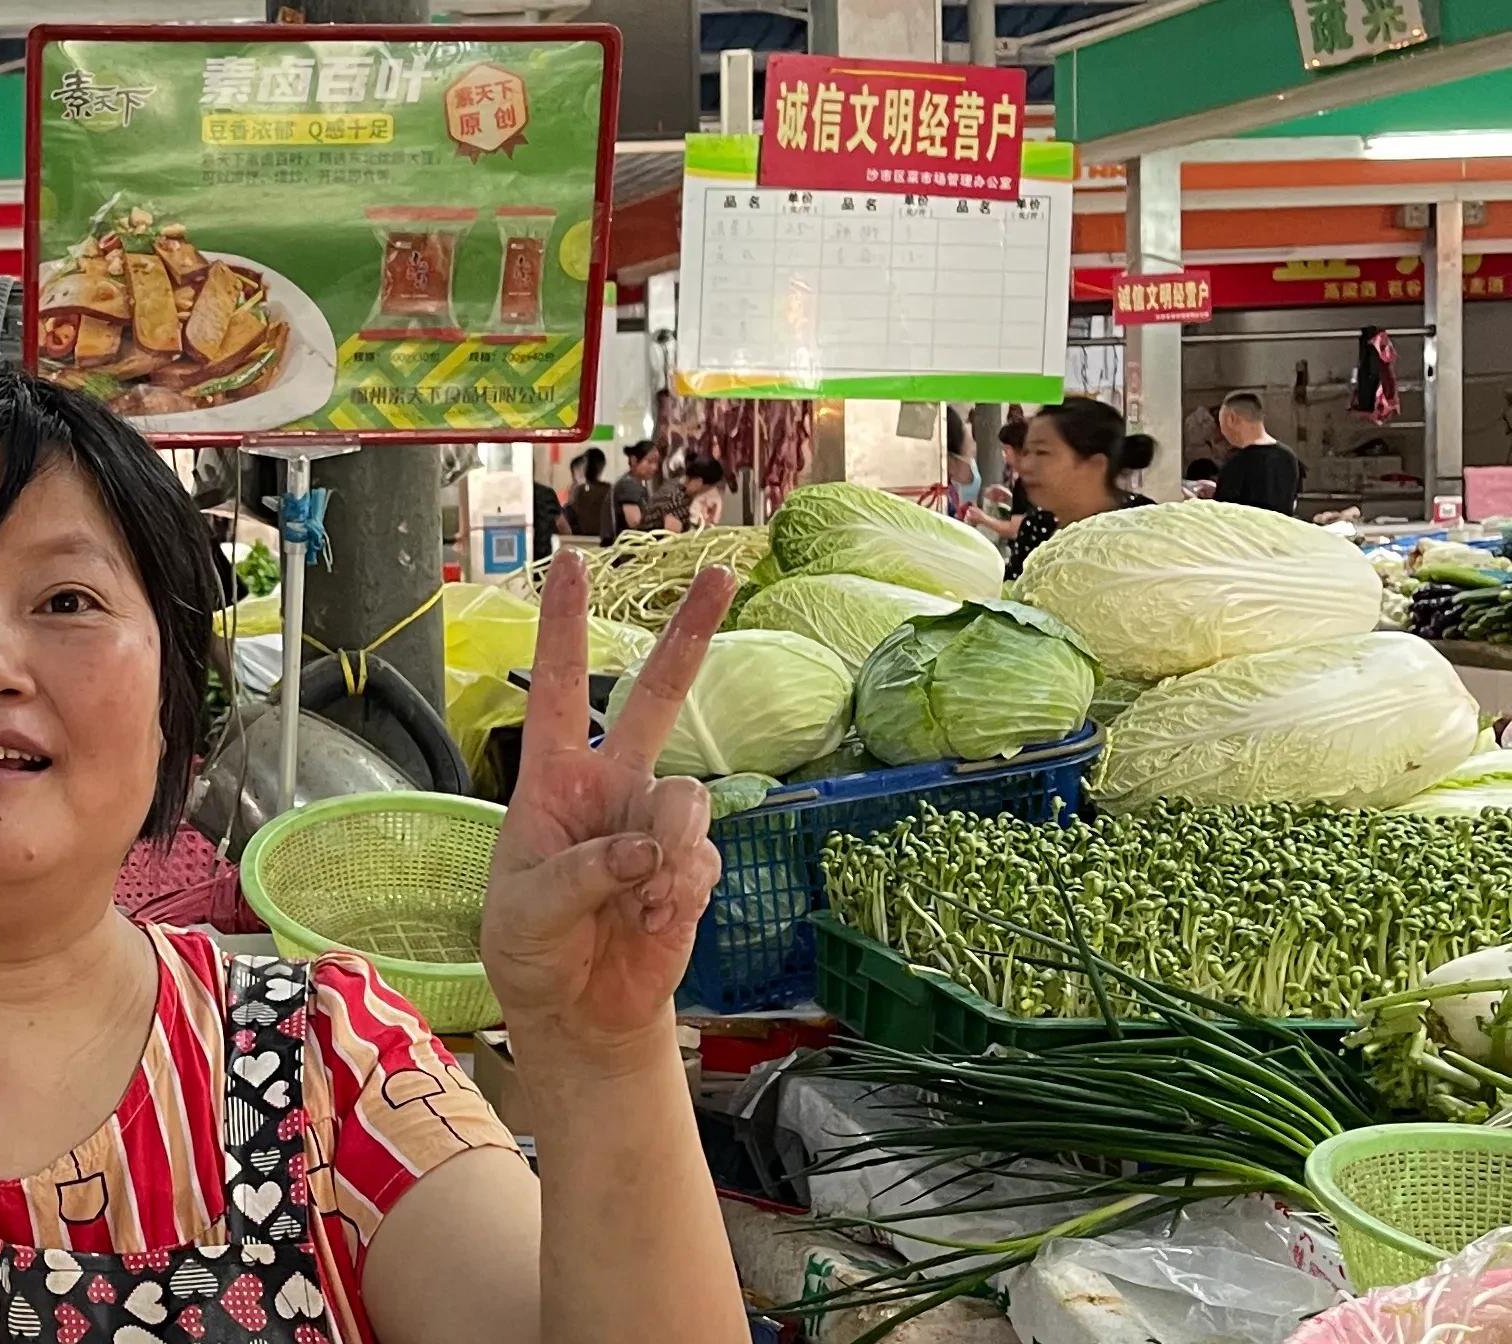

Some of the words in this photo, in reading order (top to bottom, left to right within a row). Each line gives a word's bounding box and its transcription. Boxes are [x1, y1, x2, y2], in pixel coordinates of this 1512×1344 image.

[200, 56, 431, 103] 素卤百叶
[455, 80, 513, 109] 素天下
[51, 68, 156, 127] 素天下
[209, 119, 294, 142] 豆香浓郁
[308, 118, 388, 143] Q感十足
[460, 105, 518, 136] 原创
[776, 81, 1017, 162] 诚信文明经营户
[1117, 280, 1210, 313] 诚信文明经营户
